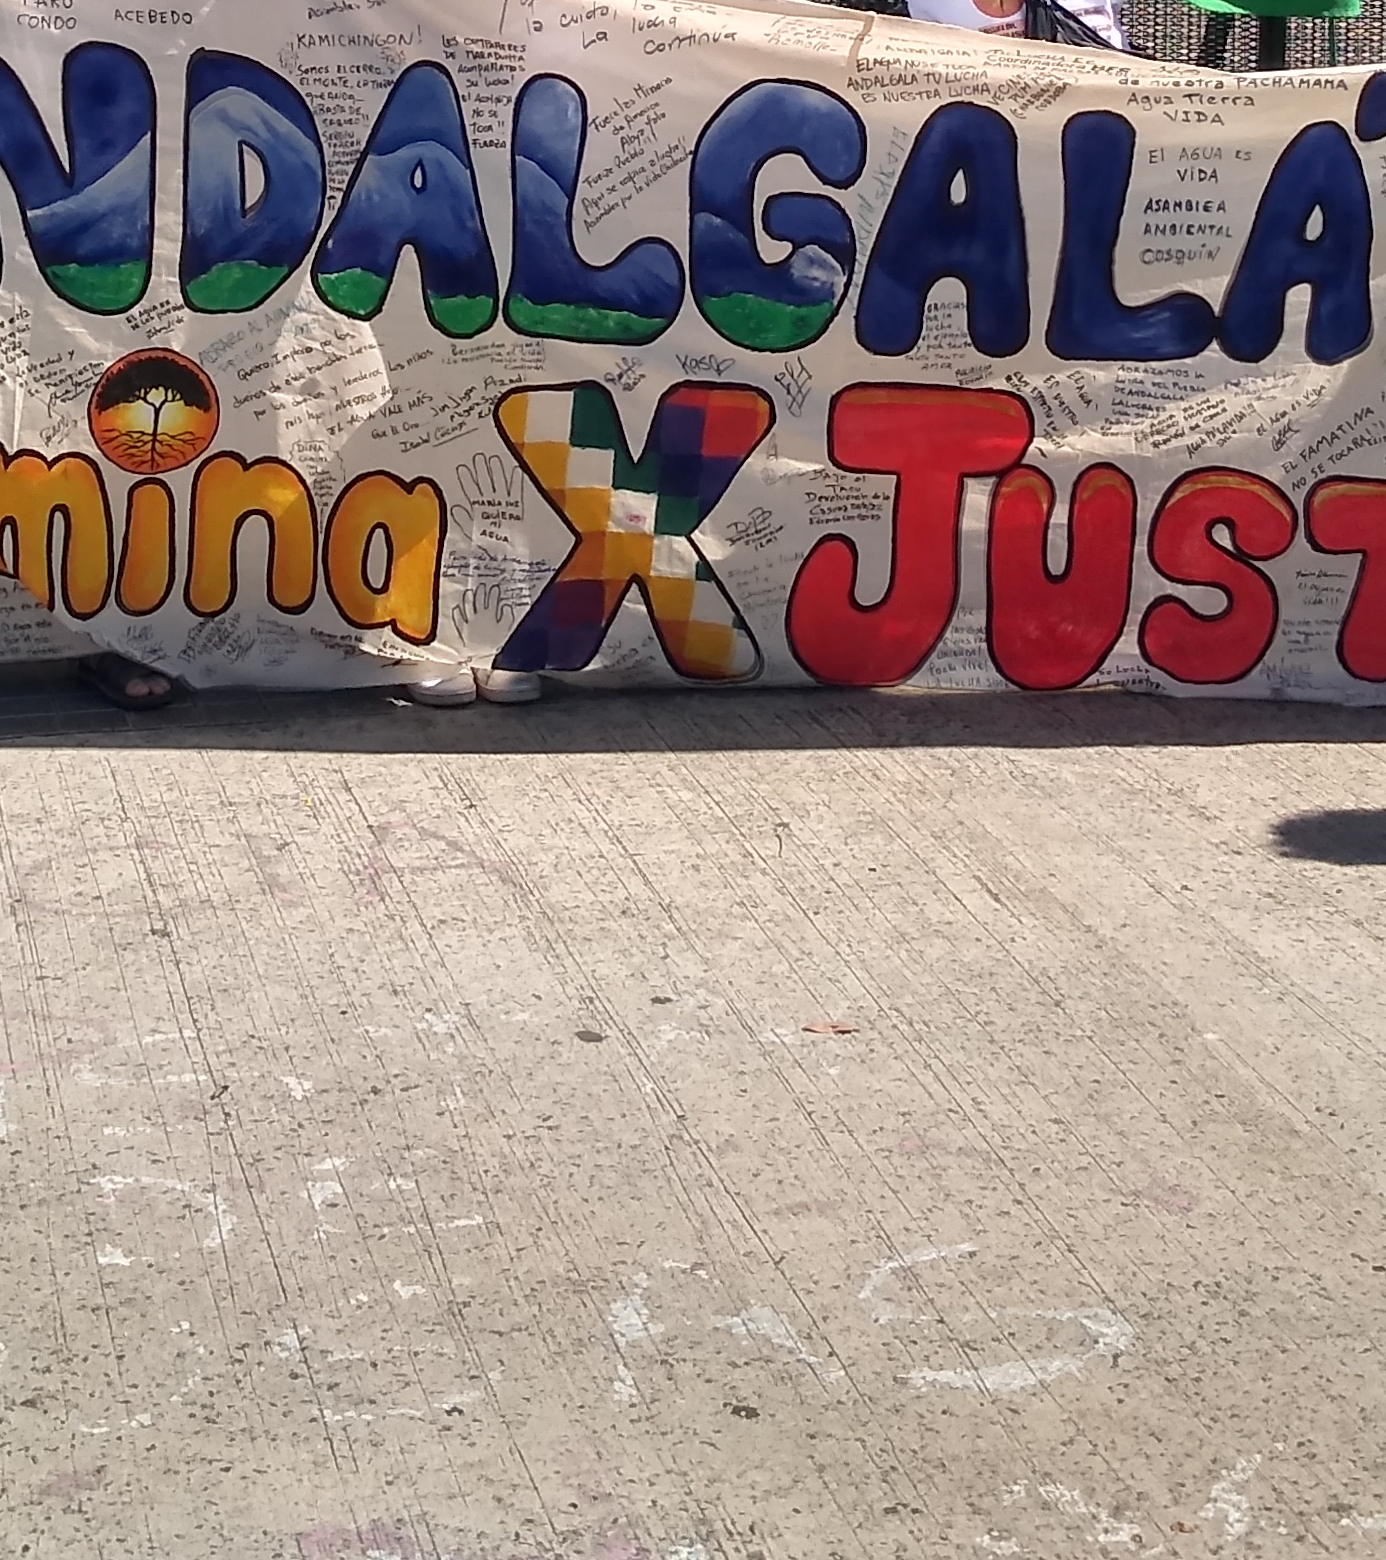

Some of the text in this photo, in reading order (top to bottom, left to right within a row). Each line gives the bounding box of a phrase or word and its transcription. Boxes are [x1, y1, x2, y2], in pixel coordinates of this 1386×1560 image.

[113, 8, 193, 25] ACEBEDO
[1162, 109, 1225, 125] VIDA
[492, 379, 778, 687] X
